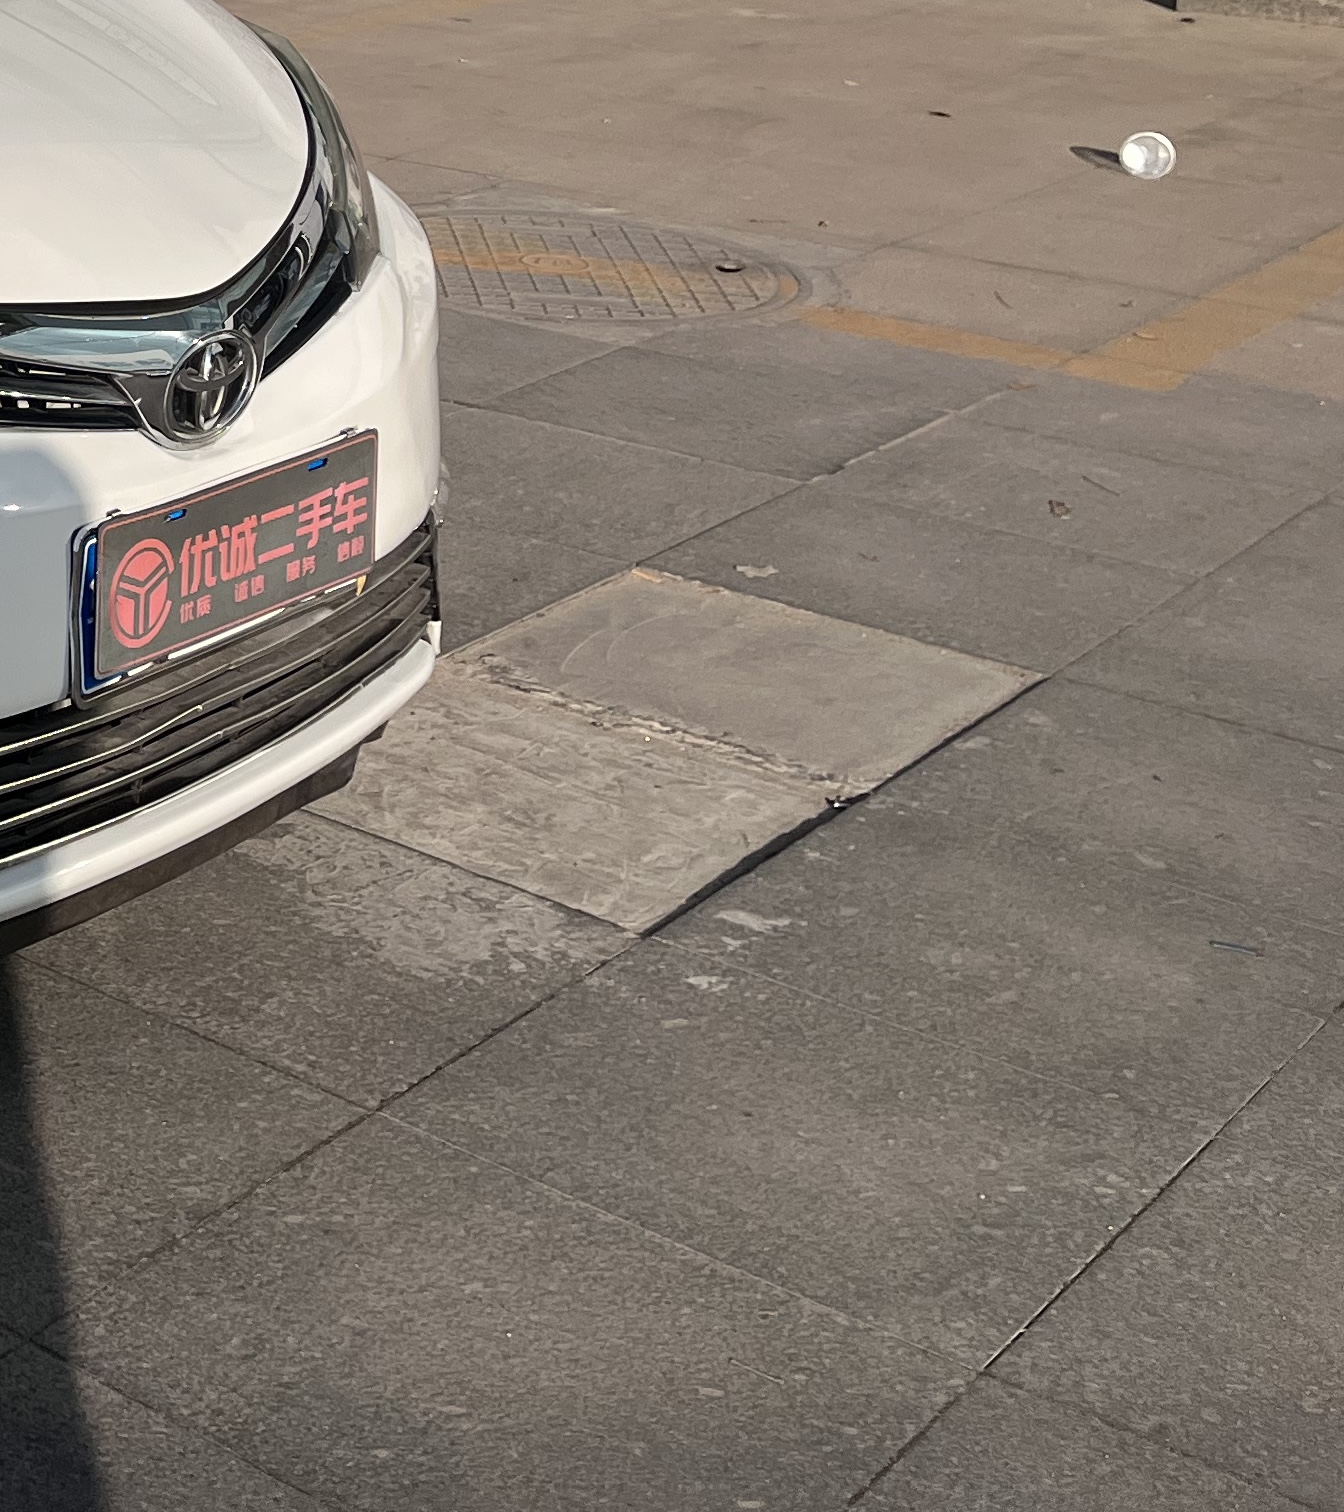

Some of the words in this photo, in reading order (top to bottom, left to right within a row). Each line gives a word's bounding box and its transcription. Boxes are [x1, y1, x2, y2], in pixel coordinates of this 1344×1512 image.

[179, 476, 369, 597] 优诚二手车
[180, 594, 211, 625] 优质
[234, 575, 265, 603] 诚信
[286, 555, 315, 583] 服务
